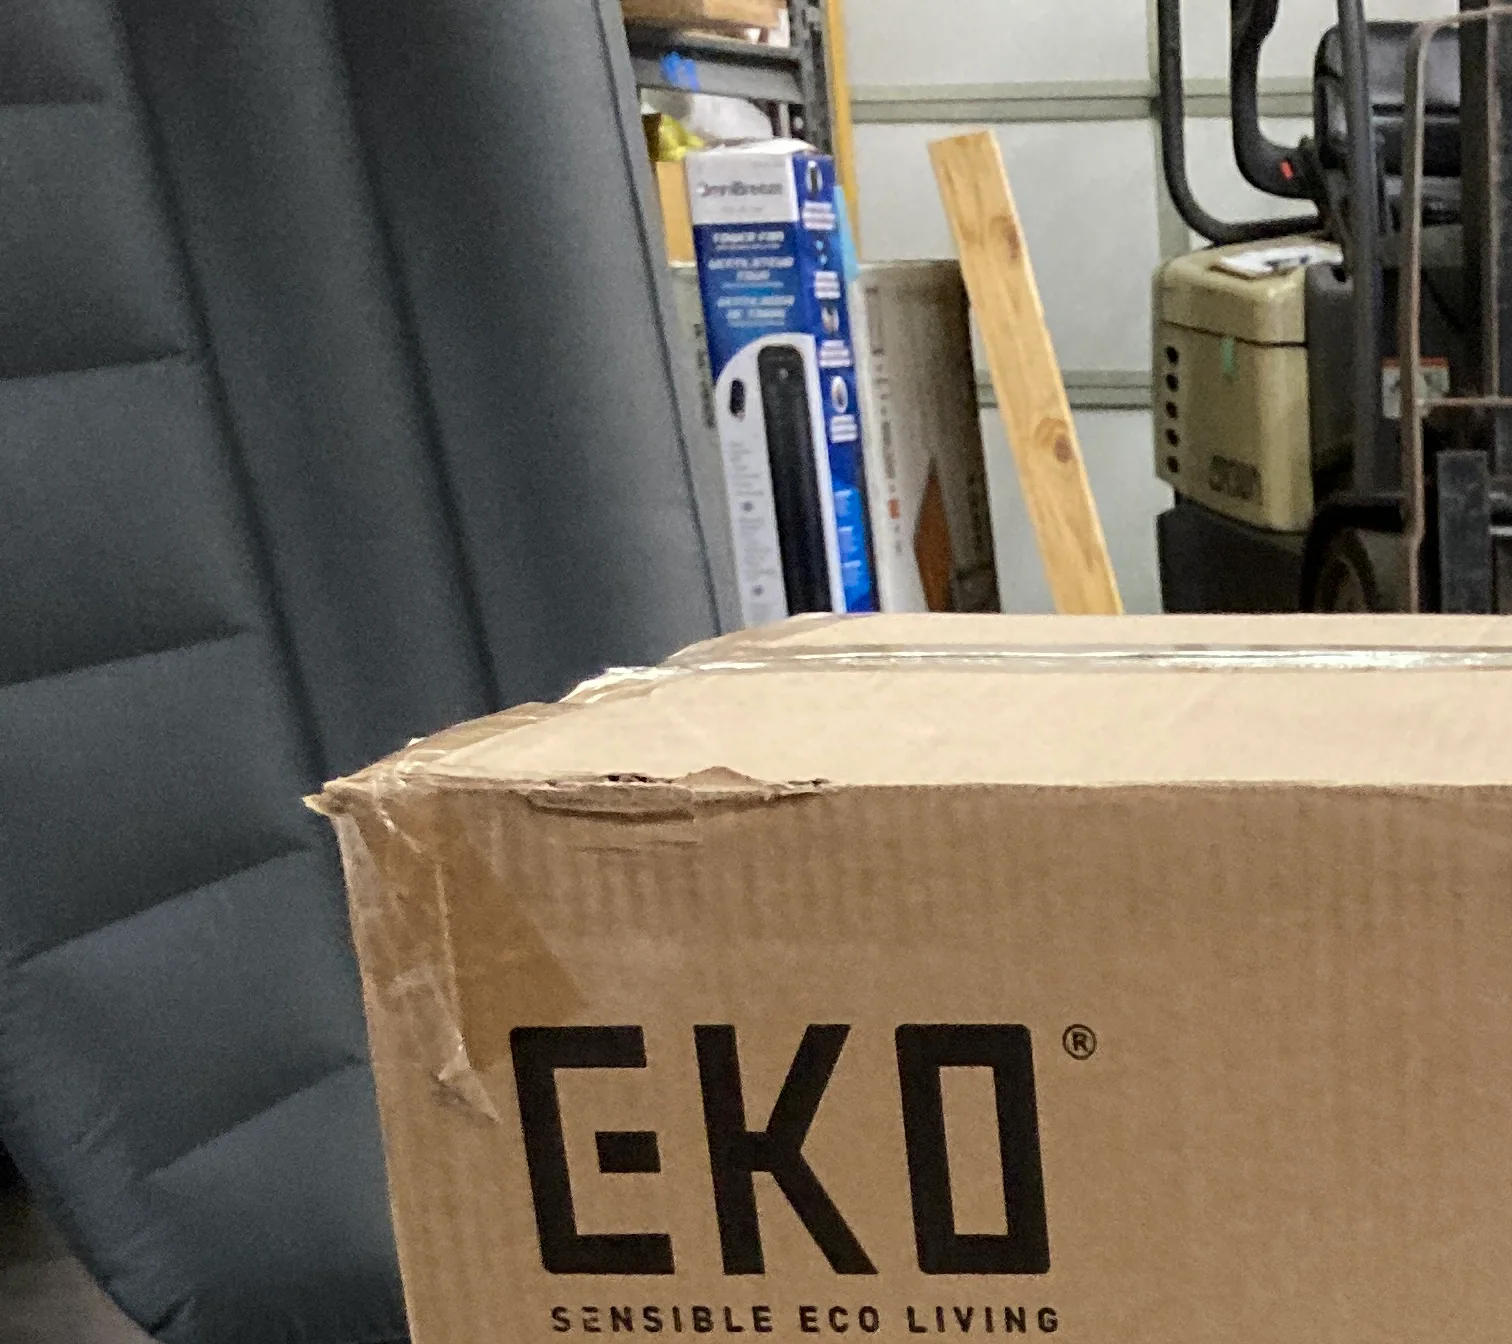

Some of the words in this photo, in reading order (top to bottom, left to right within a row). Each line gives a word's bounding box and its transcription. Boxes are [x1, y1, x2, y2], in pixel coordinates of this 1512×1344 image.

[509, 1023, 1051, 1275] EKO
[550, 1304, 775, 1334] SENSIBLE
[799, 1304, 882, 1334] ECO
[906, 1304, 1060, 1334] LIVING
